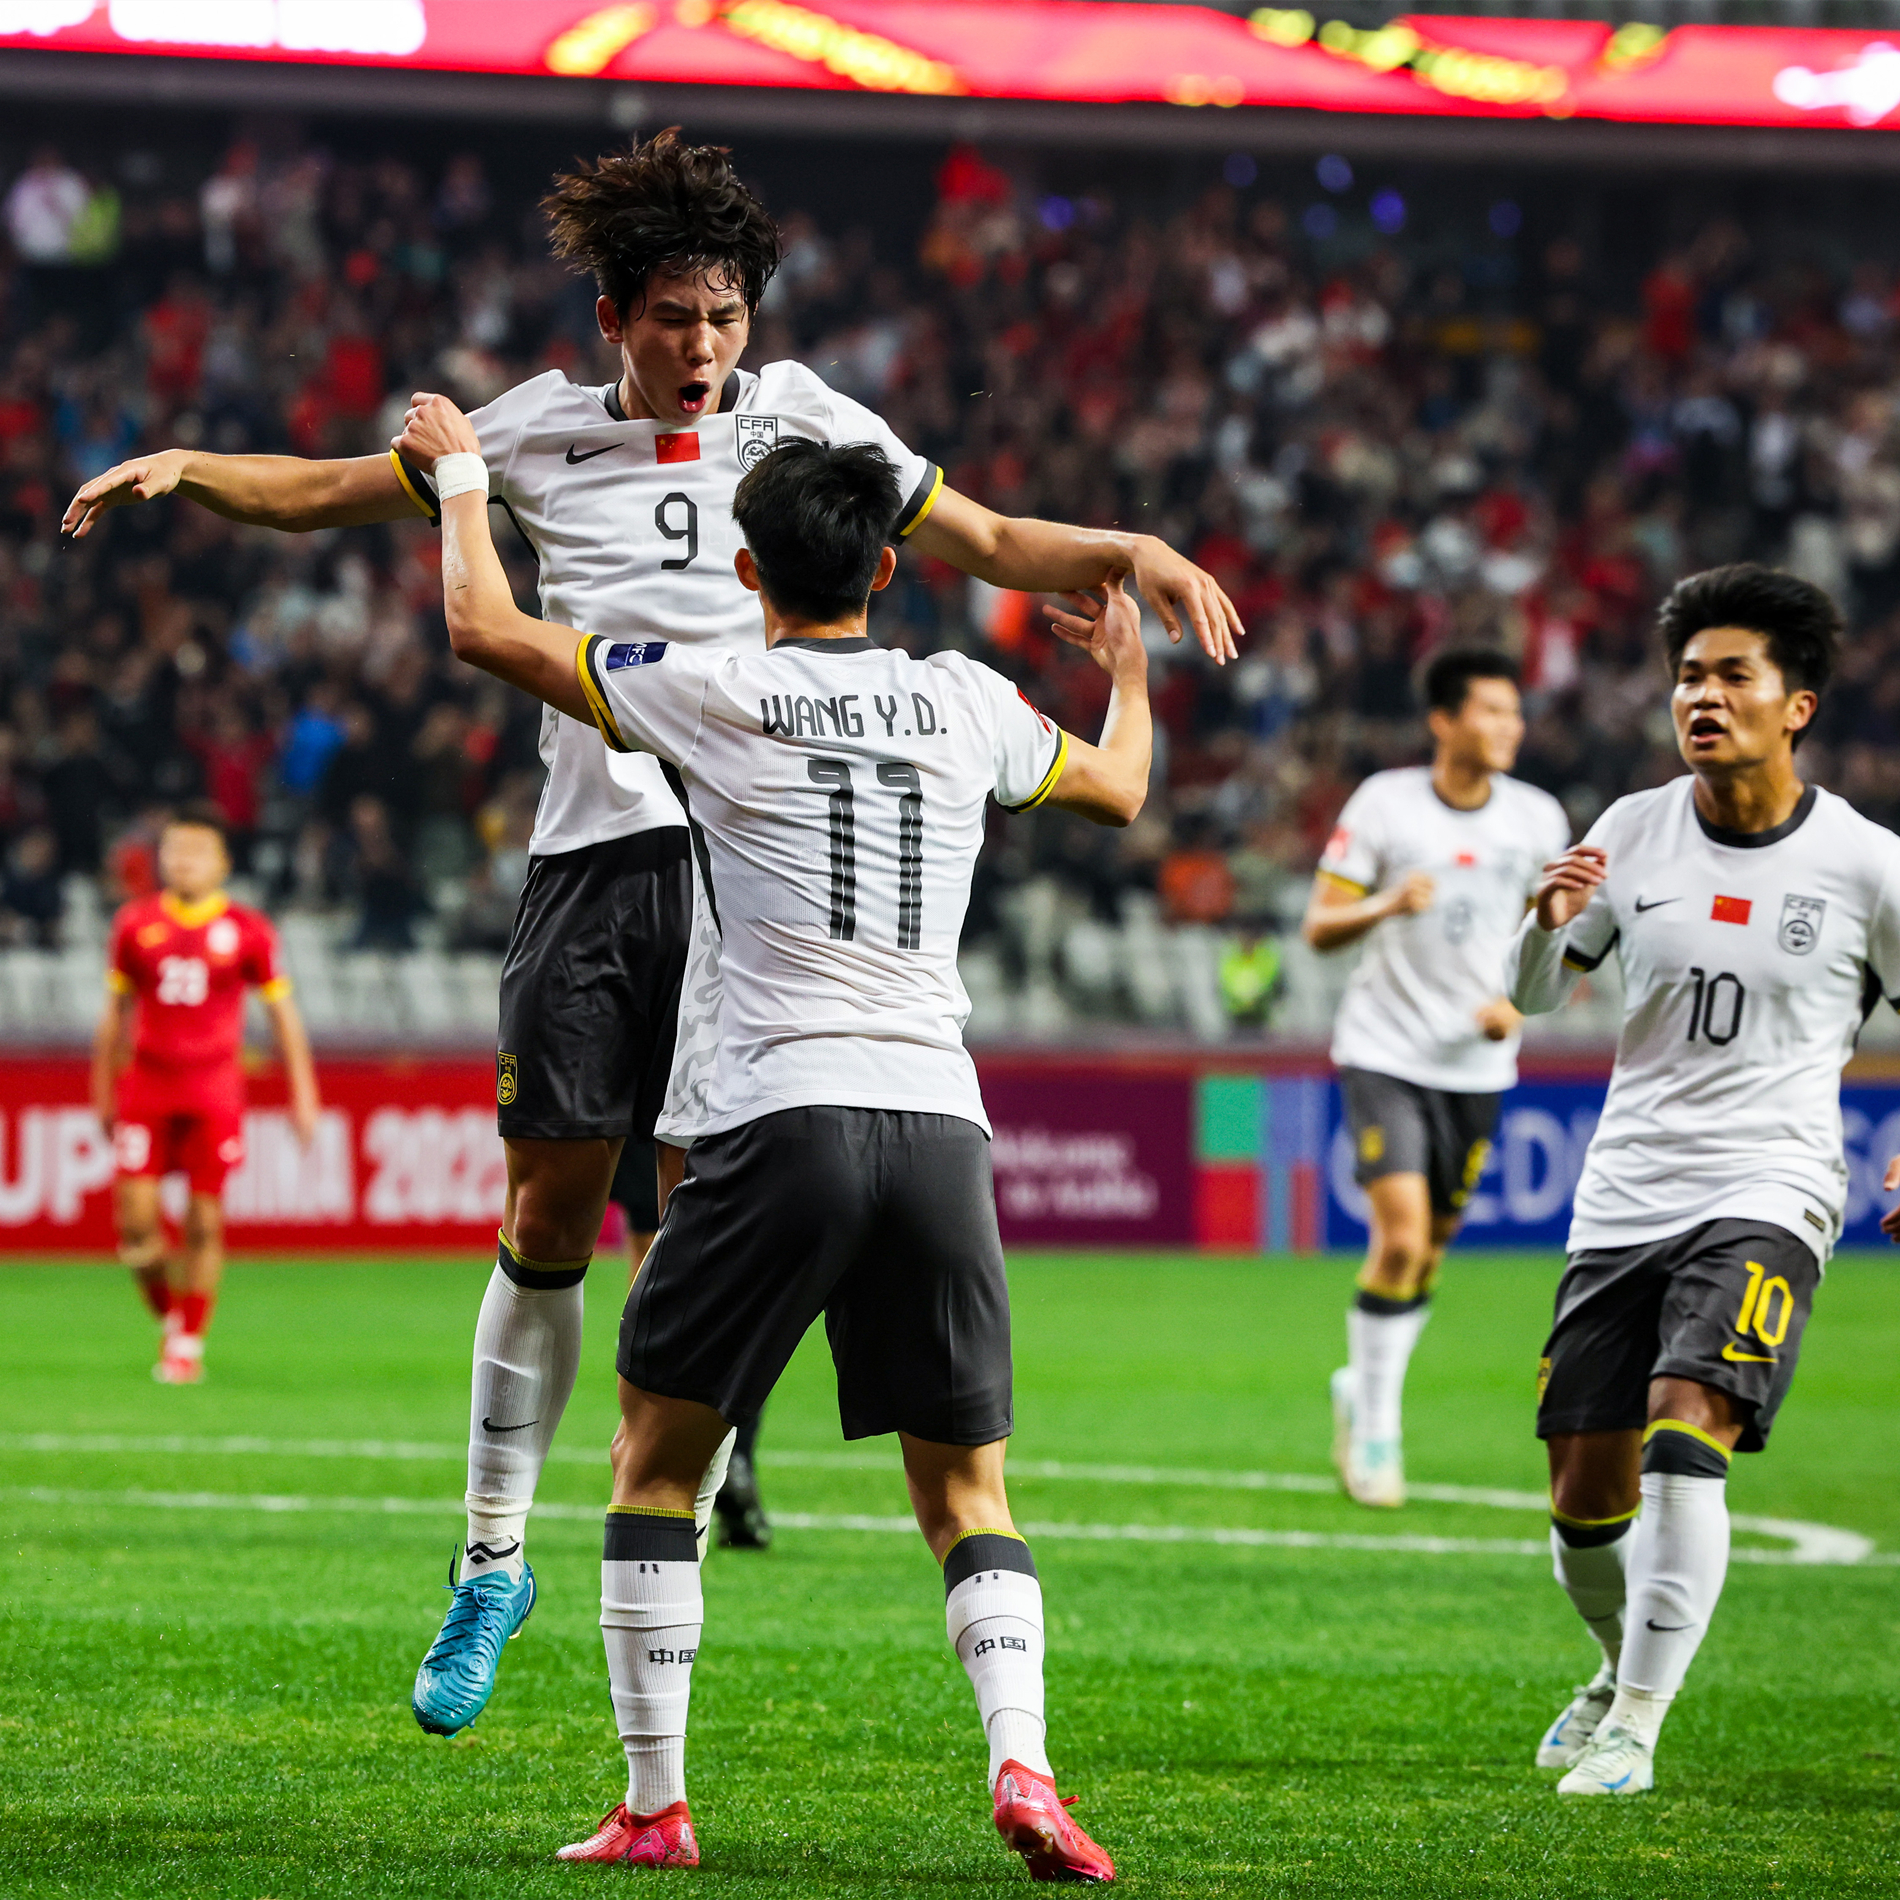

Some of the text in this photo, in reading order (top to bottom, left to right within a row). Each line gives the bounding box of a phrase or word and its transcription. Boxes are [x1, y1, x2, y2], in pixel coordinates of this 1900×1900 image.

[740, 418, 773, 431] CFA
[655, 492, 699, 570] 9
[760, 692, 948, 738] WANG Y.D.
[807, 759, 923, 950] 11
[1687, 966, 1745, 1047] 10
[1735, 1260, 1794, 1347] 10
[649, 1648, 697, 1665] 中国
[974, 1636, 1027, 1658] 中国
